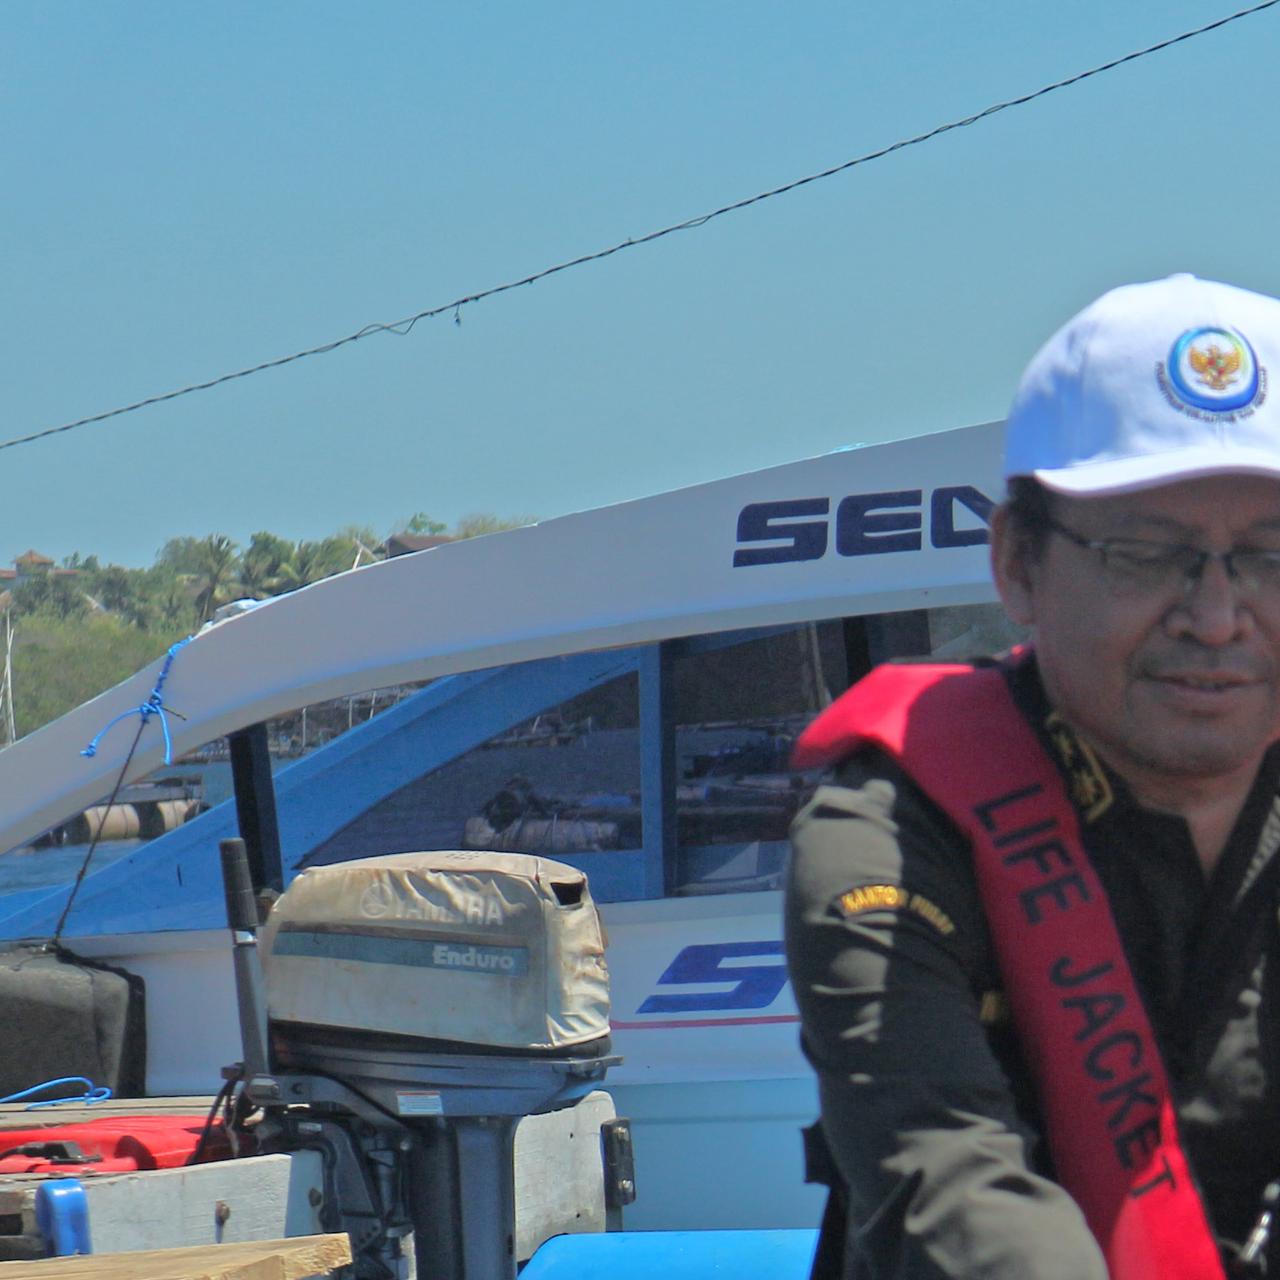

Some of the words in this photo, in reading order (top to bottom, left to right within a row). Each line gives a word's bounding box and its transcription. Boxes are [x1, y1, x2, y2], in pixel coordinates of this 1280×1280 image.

[432, 945, 515, 970] Enduro
[974, 784, 1092, 926] LIFE
[1049, 955, 1178, 1198] JACKET
